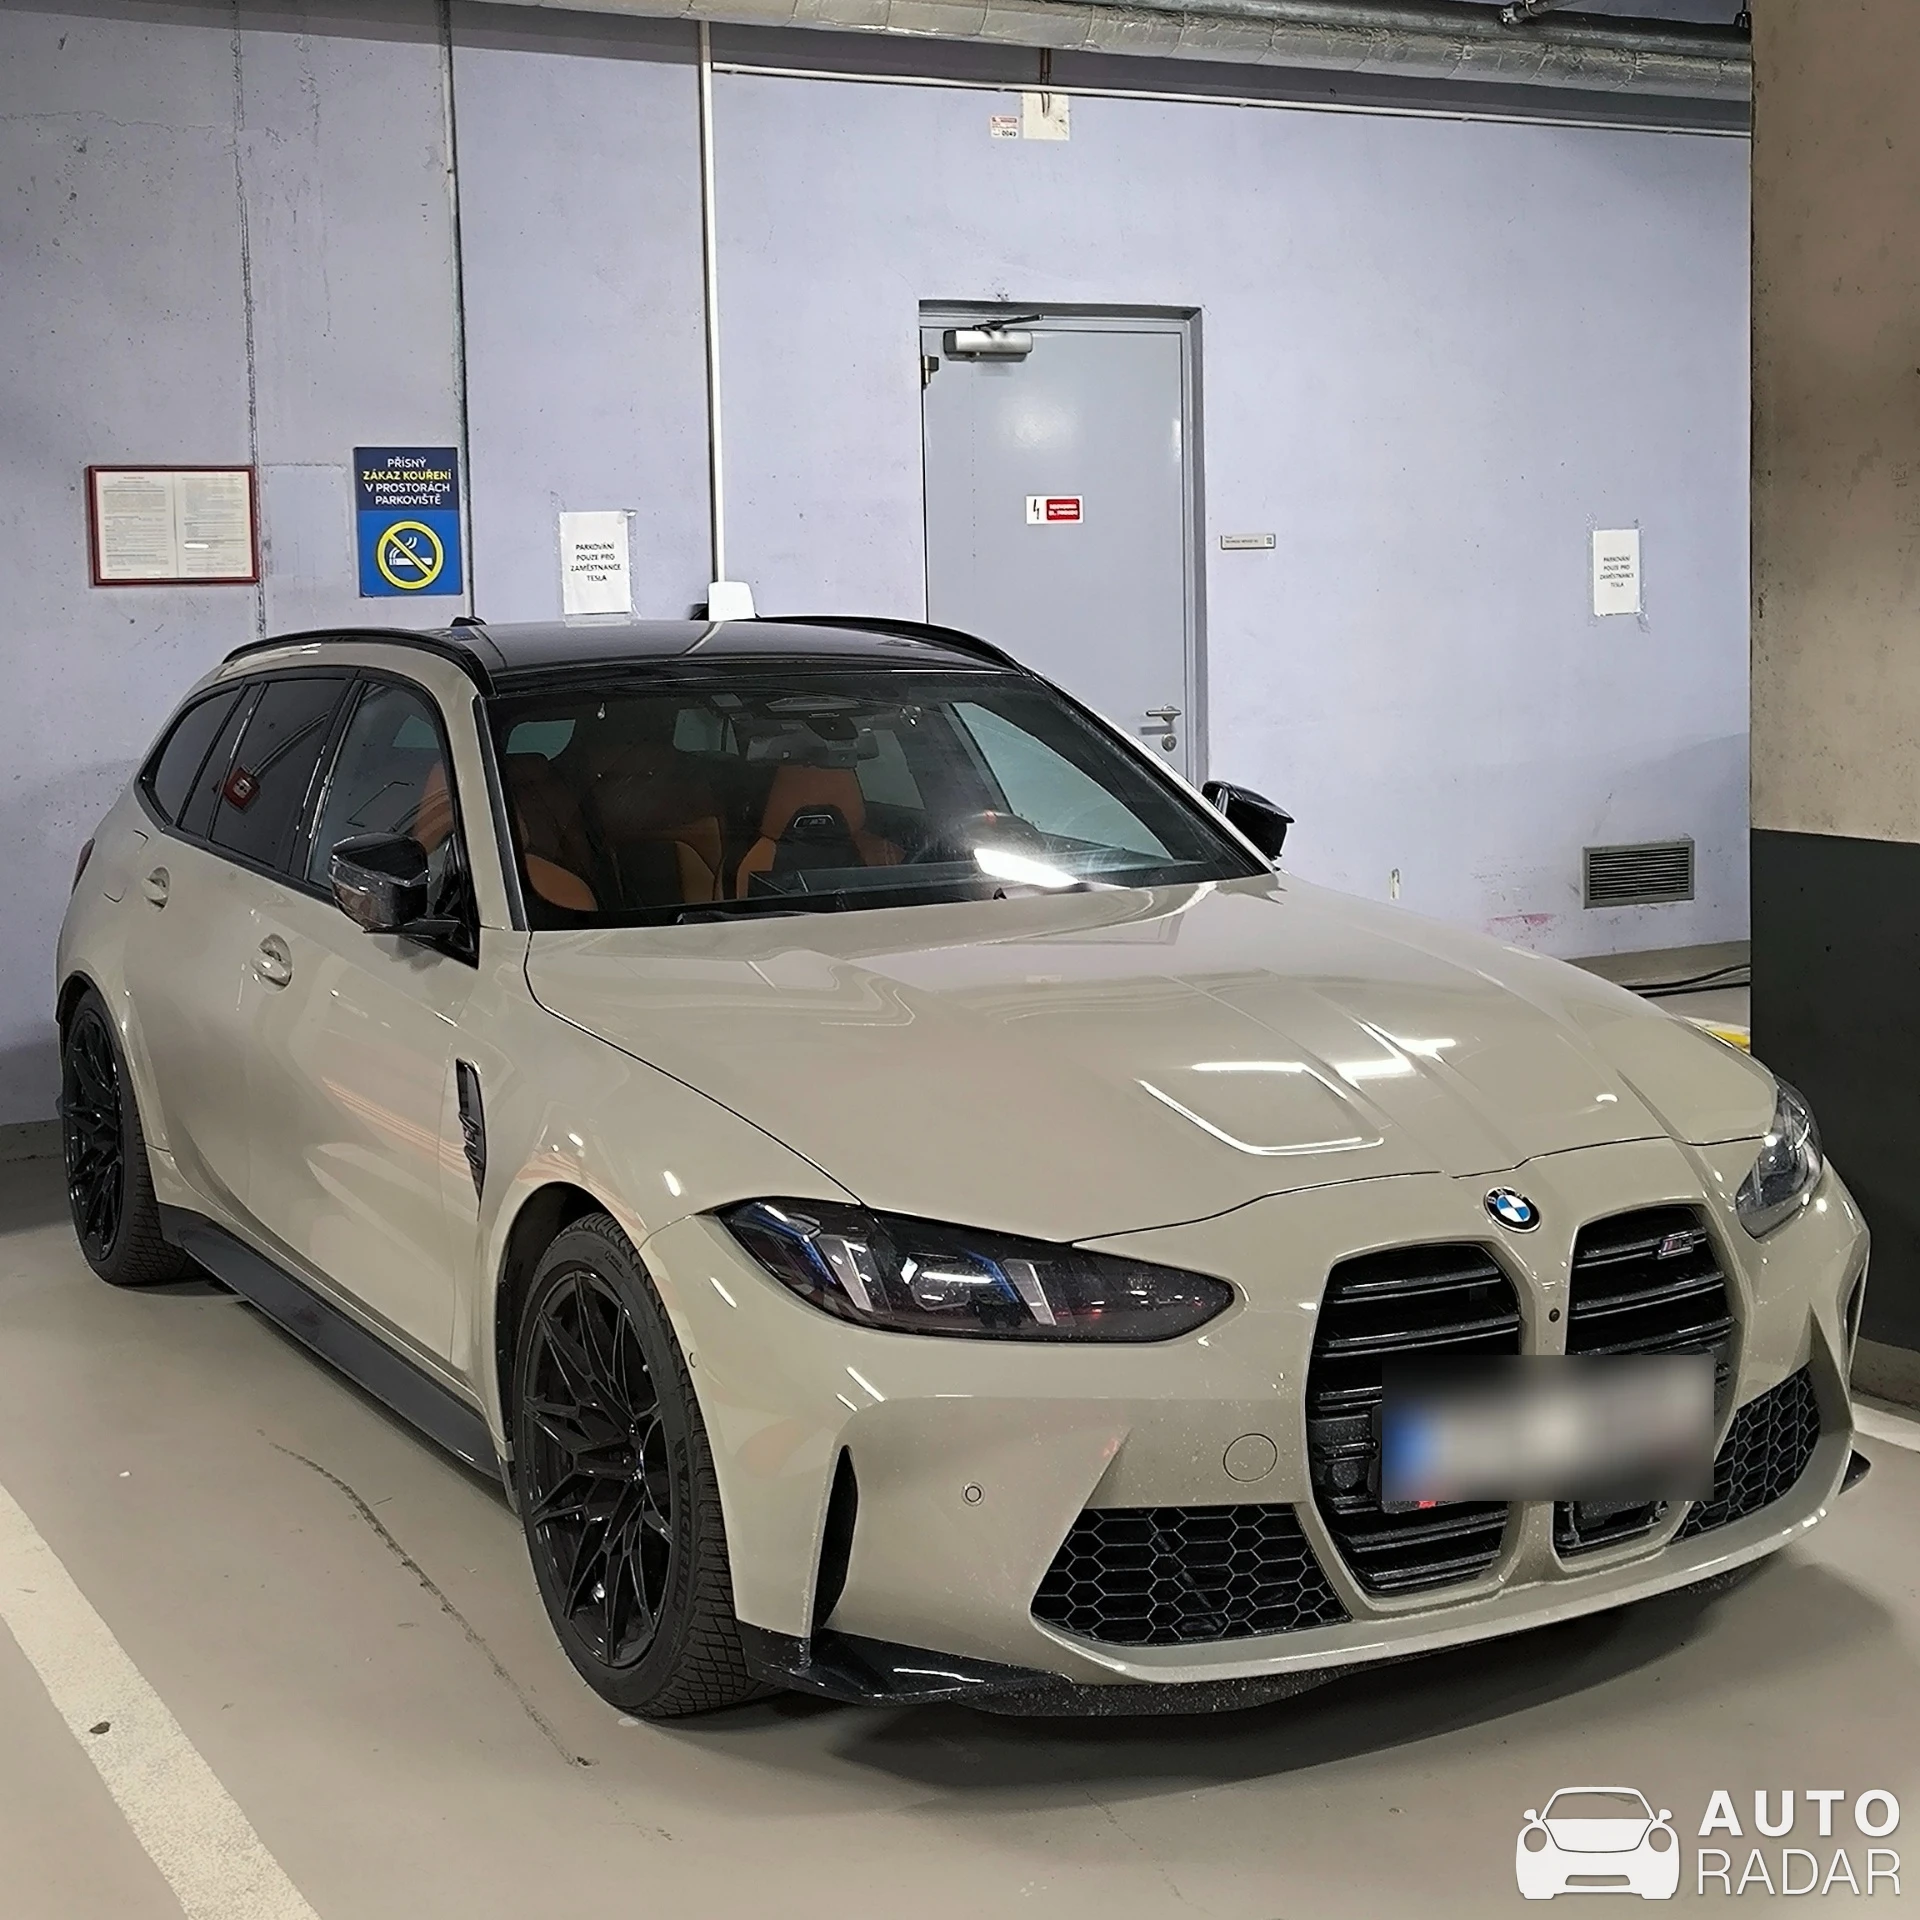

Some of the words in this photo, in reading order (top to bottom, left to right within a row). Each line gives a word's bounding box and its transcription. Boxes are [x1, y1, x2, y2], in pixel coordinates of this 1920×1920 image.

[387, 456, 427, 468] PŘÍSNÝ
[363, 469, 401, 481] ZÁKAZ
[403, 469, 452, 480] KOUŘENÍ
[365, 483, 374, 493] V
[376, 481, 451, 493] PROSTORÁCH
[375, 493, 442, 505] PARKOVIŠTĚ
[600, 553, 615, 561] PRO
[586, 574, 607, 582] TESLA
